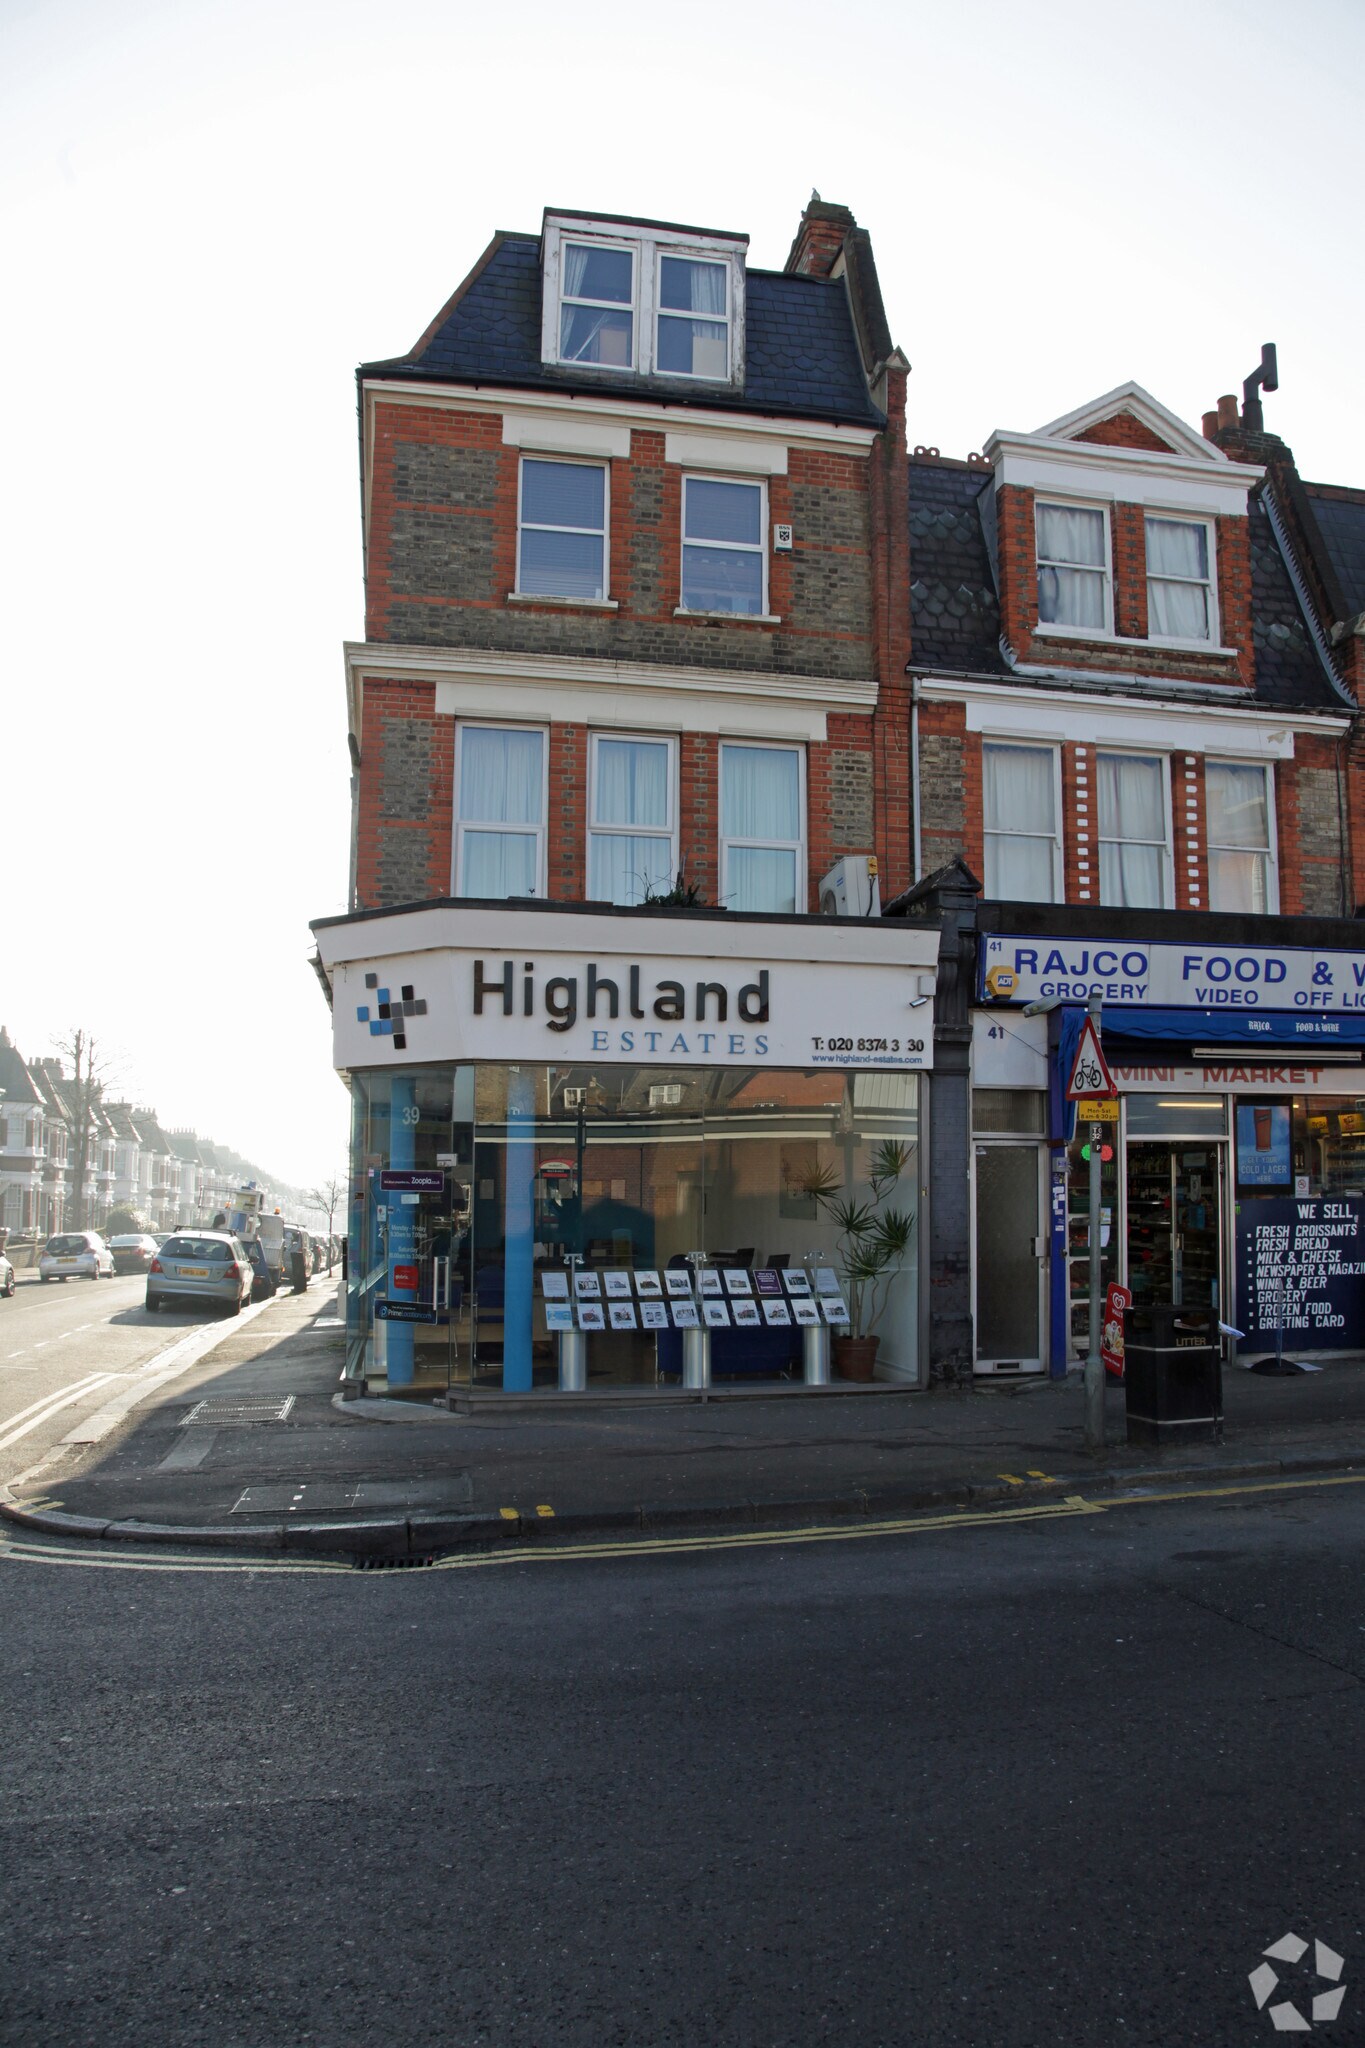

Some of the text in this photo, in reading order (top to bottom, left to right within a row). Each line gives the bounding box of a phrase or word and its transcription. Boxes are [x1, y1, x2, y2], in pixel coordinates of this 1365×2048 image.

[989, 942, 1002, 952] 41
[1015, 949, 1148, 977] RAJCO
[1182, 955, 1287, 983] FOOD
[1311, 961, 1334, 986] &
[998, 977, 1013, 986] ADT
[473, 959, 769, 1032] Highland
[1040, 983, 1259, 1005] GROCERY VIDEO
[1294, 991, 1333, 1006] OFF
[988, 1026, 1004, 1039] 41
[1295, 1022, 1340, 1032] FOOD & WINE
[591, 1030, 769, 1055] ESTATES
[811, 1037, 824, 1050] T:
[828, 1038, 854, 1051] 020
[857, 1038, 888, 1051] 8374
[1113, 1066, 1175, 1082] MINI
[1203, 1067, 1324, 1084] MARKET
[402, 1106, 420, 1125] 39
[1240, 1165, 1288, 1174] COLD LAGER
[1256, 1175, 1272, 1183] HERE
[1297, 1204, 1317, 1219] WE
[1256, 1224, 1358, 1238] FRESH CROISSANTS
[1256, 1238, 1329, 1252] FRESH BREAD
[1256, 1250, 1342, 1264] MILK & CHEESE
[1256, 1262, 1365, 1278] NEWSPAPER & MAGAZI
[1286, 1278, 1294, 1290] &
[1299, 1276, 1328, 1289] BEER
[1258, 1290, 1308, 1303] GROCERY
[1258, 1302, 1332, 1316] FROZEN FOOD
[1315, 1315, 1345, 1328] CARD
[1176, 1336, 1206, 1347] LITTER
